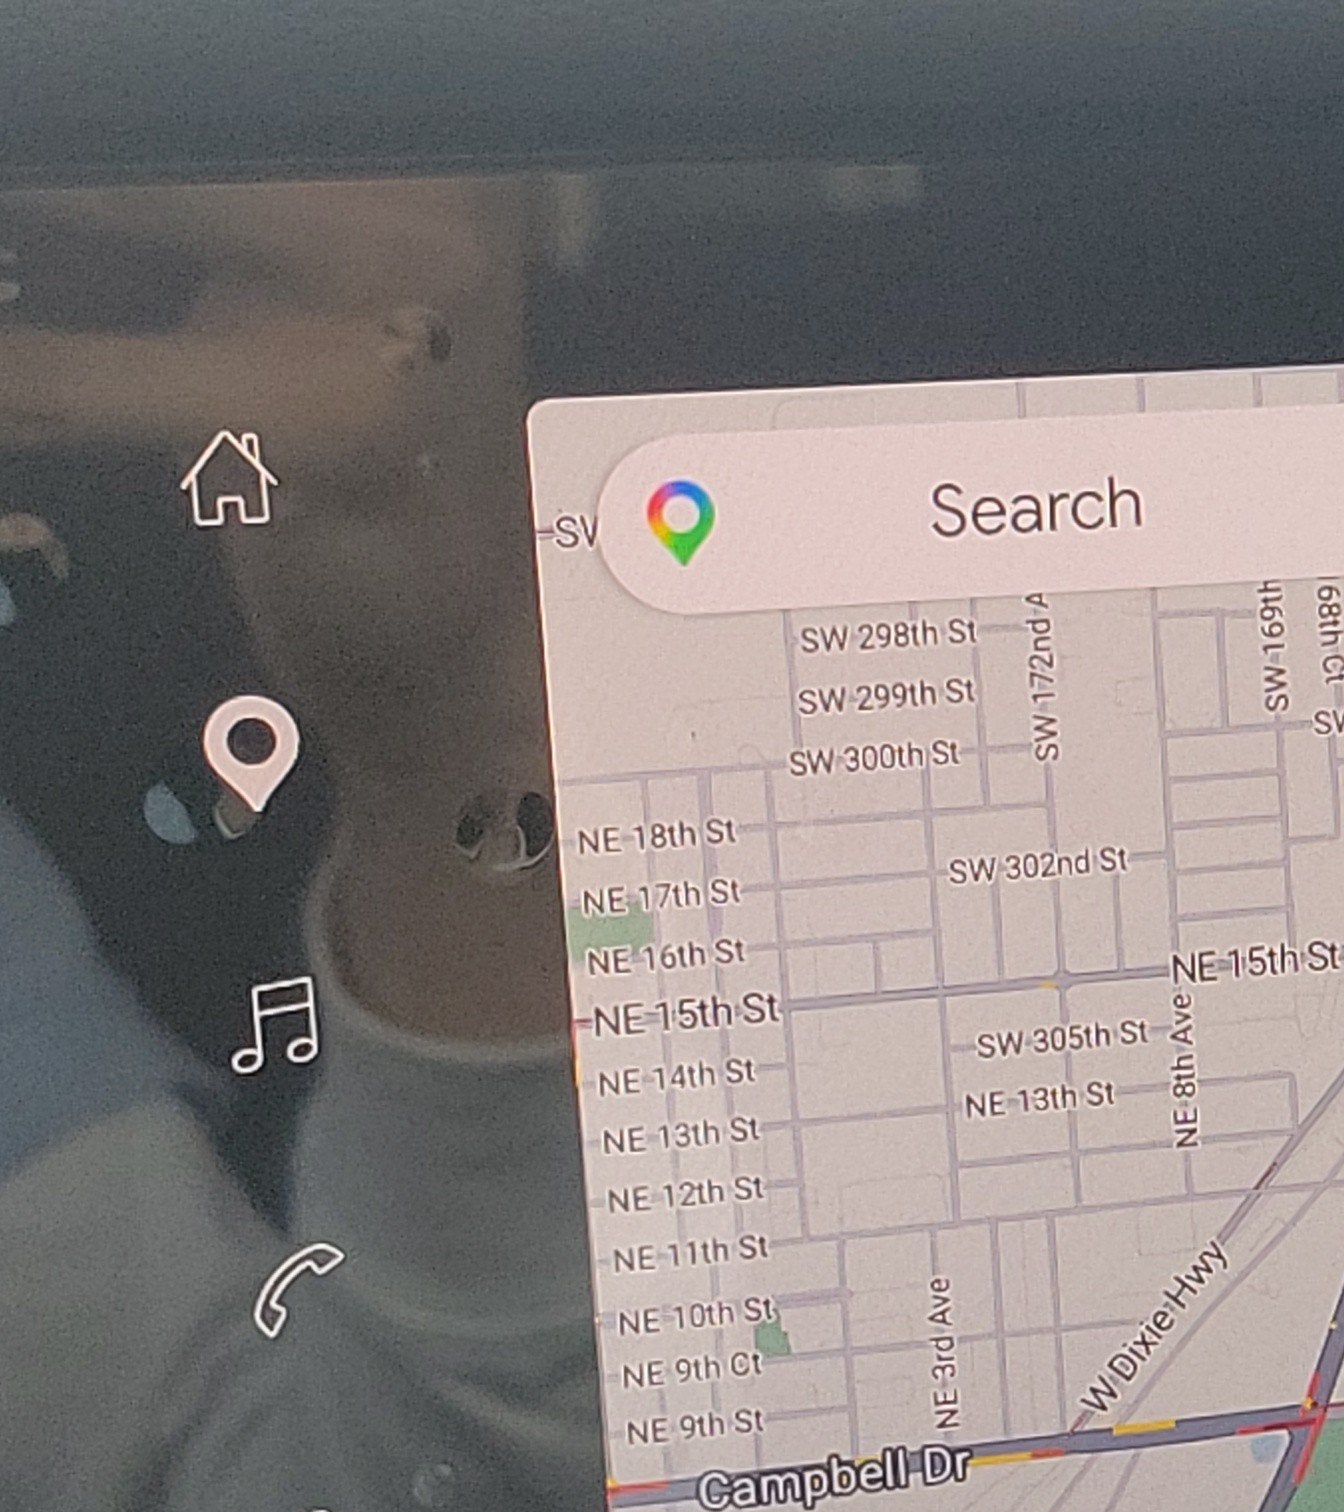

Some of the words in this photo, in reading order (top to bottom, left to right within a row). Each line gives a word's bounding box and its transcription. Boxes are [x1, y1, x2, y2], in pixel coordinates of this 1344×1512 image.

[931, 476, 1142, 538] Search
[800, 628, 847, 653] SW
[858, 621, 937, 650] 298th
[948, 618, 977, 643] St
[1257, 580, 1285, 655] 169th
[1025, 618, 1055, 703] 172nd
[799, 689, 845, 715] SW
[857, 681, 935, 711] 299th
[946, 679, 975, 703] St
[1264, 666, 1289, 711] SW
[1032, 714, 1059, 761] SW
[790, 750, 834, 776] SW
[844, 743, 923, 772] 300th
[933, 740, 960, 765] St
[578, 829, 620, 854] NE
[633, 822, 696, 850] 18th
[707, 819, 735, 844] St
[949, 859, 995, 884] SW
[1005, 849, 1089, 879] 302nd
[1100, 847, 1127, 872] St
[583, 889, 624, 913] NE
[638, 881, 700, 909] 17th
[712, 879, 740, 904] St
[588, 950, 629, 974] NE
[644, 941, 705, 969] 16th
[715, 938, 745, 964] St
[1172, 953, 1217, 983] NE
[1229, 945, 1299, 978] 15th
[1308, 942, 1340, 971] St
[594, 1006, 643, 1036] NE
[656, 998, 732, 1030] 15th
[743, 994, 778, 1024] St
[1170, 993, 1193, 1046] Ave
[978, 1031, 1023, 1058] SW
[1033, 1022, 1110, 1052] 305th
[1120, 1020, 1149, 1045] St
[600, 1072, 639, 1096] NE
[654, 1062, 714, 1090] 14th
[726, 1058, 756, 1084] St
[1172, 1057, 1195, 1102] 8th
[966, 1092, 1006, 1118] NE
[1018, 1084, 1077, 1112] 13th
[1087, 1082, 1114, 1107] St
[604, 1130, 644, 1154] NE
[659, 1120, 720, 1148] 13th
[730, 1117, 759, 1142] St
[1175, 1111, 1197, 1148] NE
[609, 1189, 648, 1213] NE
[663, 1179, 724, 1208] 12th
[735, 1176, 763, 1201] St
[615, 1247, 655, 1272] NE
[668, 1239, 729, 1266] 11th
[739, 1235, 768, 1260] St
[619, 1309, 659, 1335] NE
[674, 1301, 734, 1329] 10th
[744, 1297, 773, 1322] St
[928, 1278, 951, 1326] Ave
[1081, 1375, 1118, 1412] W
[1107, 1310, 1175, 1382] Dixie
[1163, 1240, 1228, 1309] Hwy
[623, 1363, 663, 1388] NE
[675, 1356, 720, 1383] 9th
[732, 1353, 761, 1377] Ct
[931, 1335, 955, 1381] 3rd
[627, 1419, 667, 1443] NE
[679, 1413, 723, 1439] 9th
[734, 1409, 764, 1433] St
[934, 1390, 958, 1428] NE
[697, 1447, 907, 1511] Campbell
[922, 1445, 972, 1486] Dr
